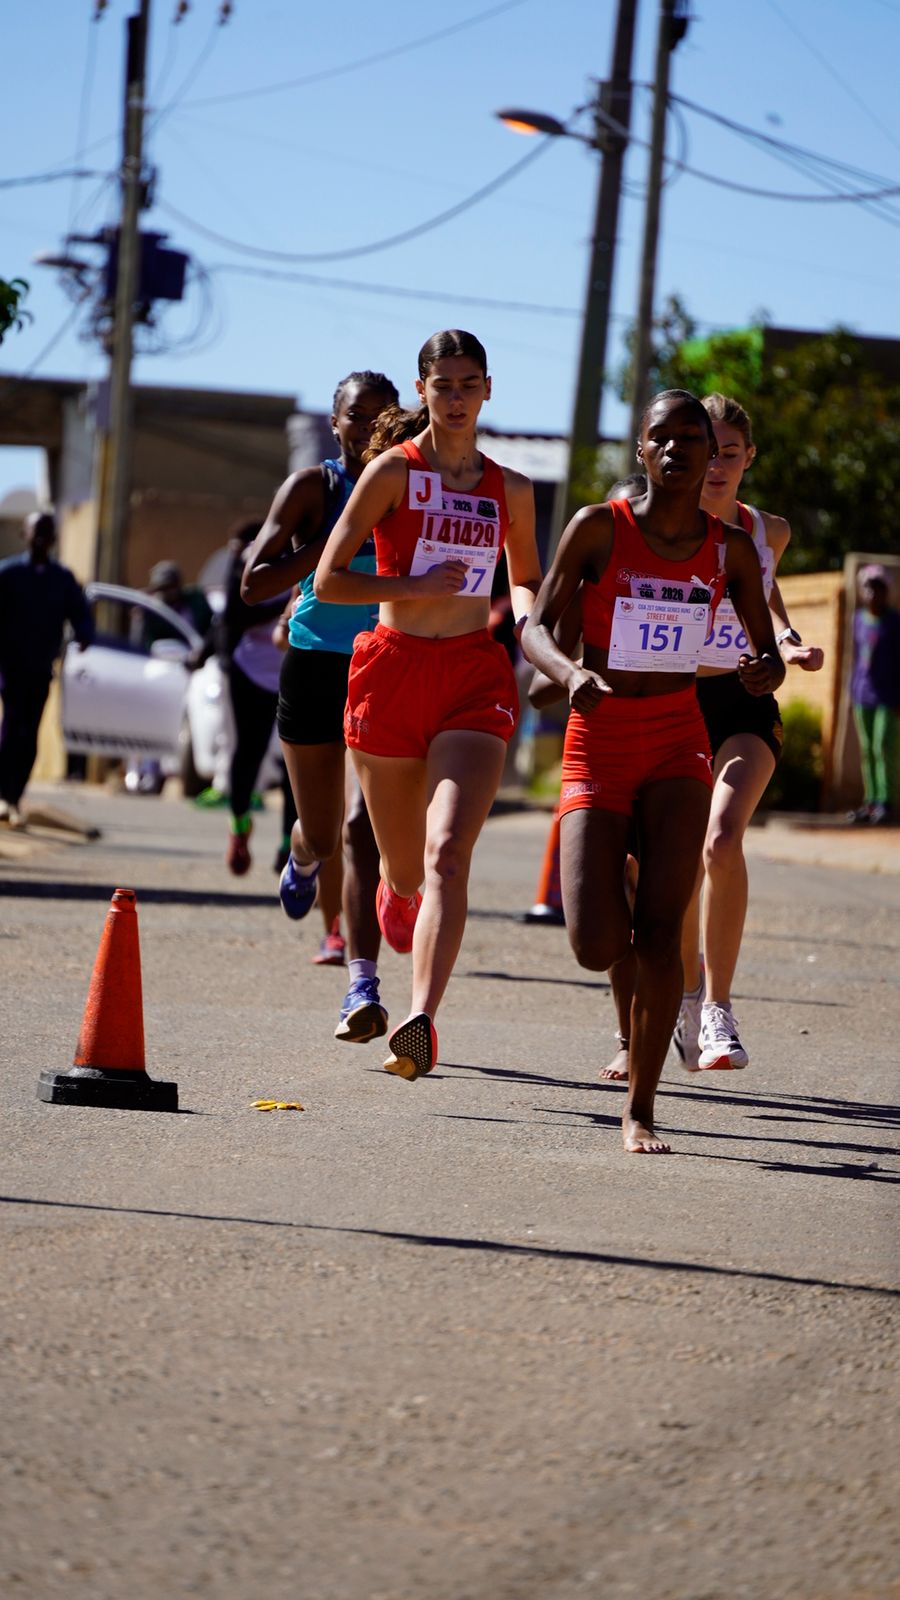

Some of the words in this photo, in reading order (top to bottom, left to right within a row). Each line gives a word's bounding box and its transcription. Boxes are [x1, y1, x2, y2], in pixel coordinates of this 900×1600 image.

[415, 477, 432, 503] J
[661, 586, 684, 602] 2026
[646, 612, 666, 621] STREET
[639, 623, 683, 652] 151
